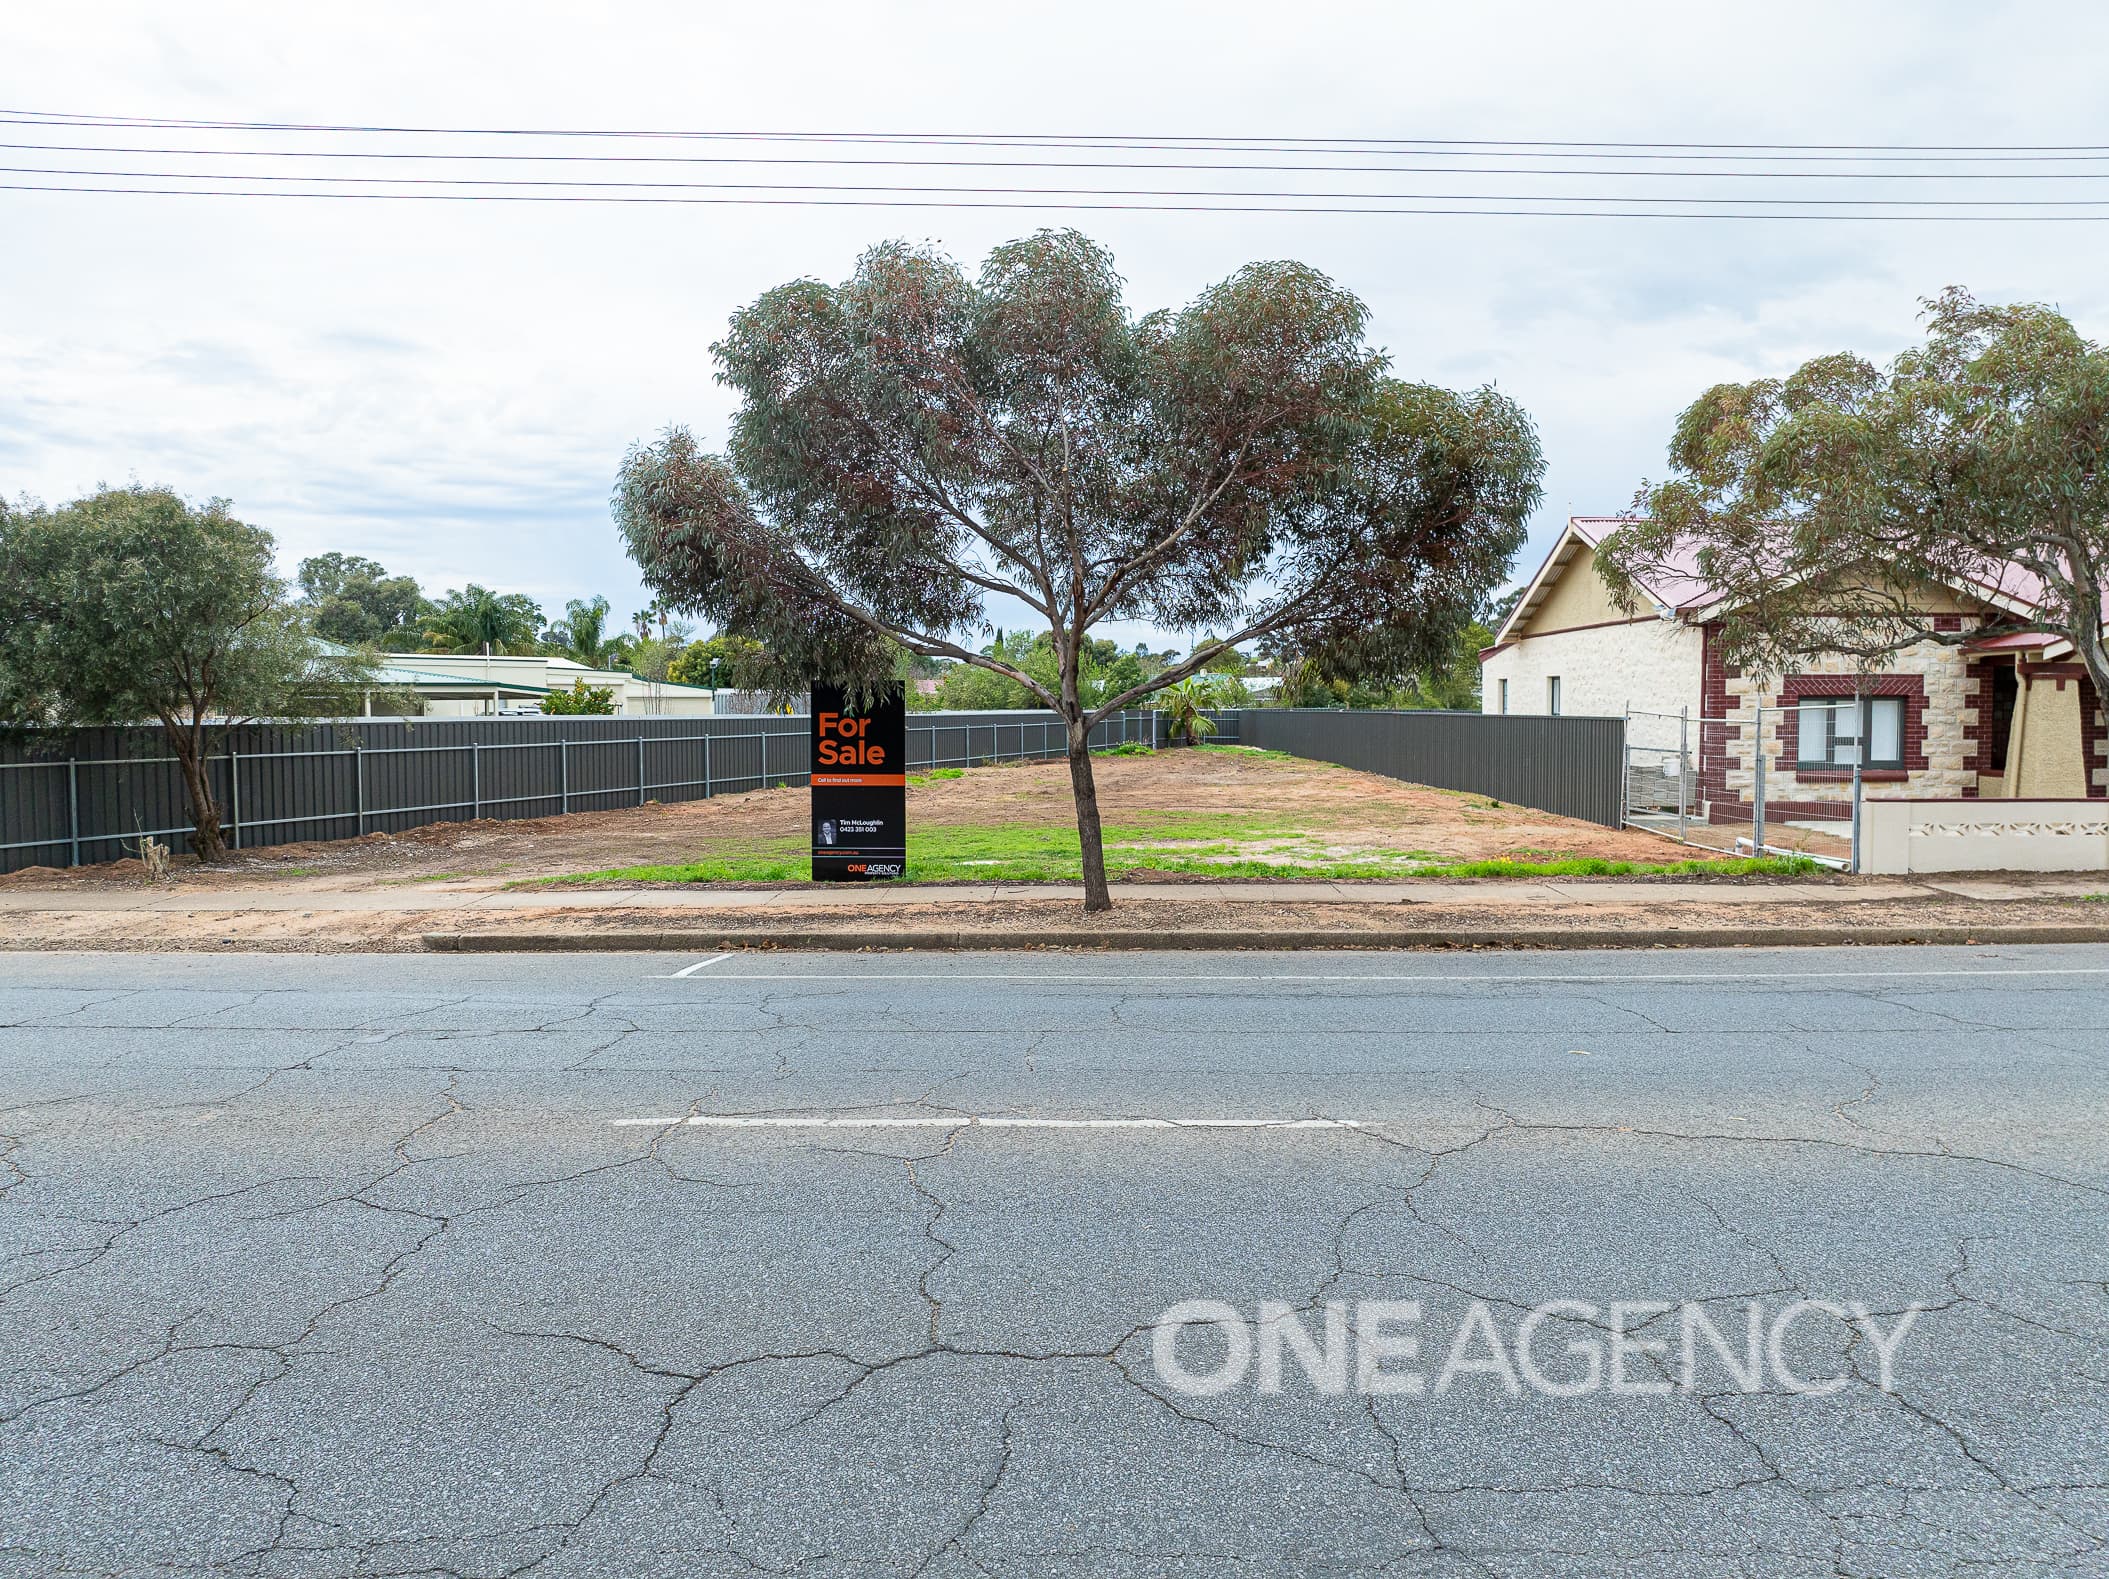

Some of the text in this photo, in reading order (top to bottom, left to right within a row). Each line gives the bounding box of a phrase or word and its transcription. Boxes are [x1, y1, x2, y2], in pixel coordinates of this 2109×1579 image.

[818, 712, 871, 738] For
[818, 740, 886, 765] Sale
[851, 819, 884, 827] McLoughlin
